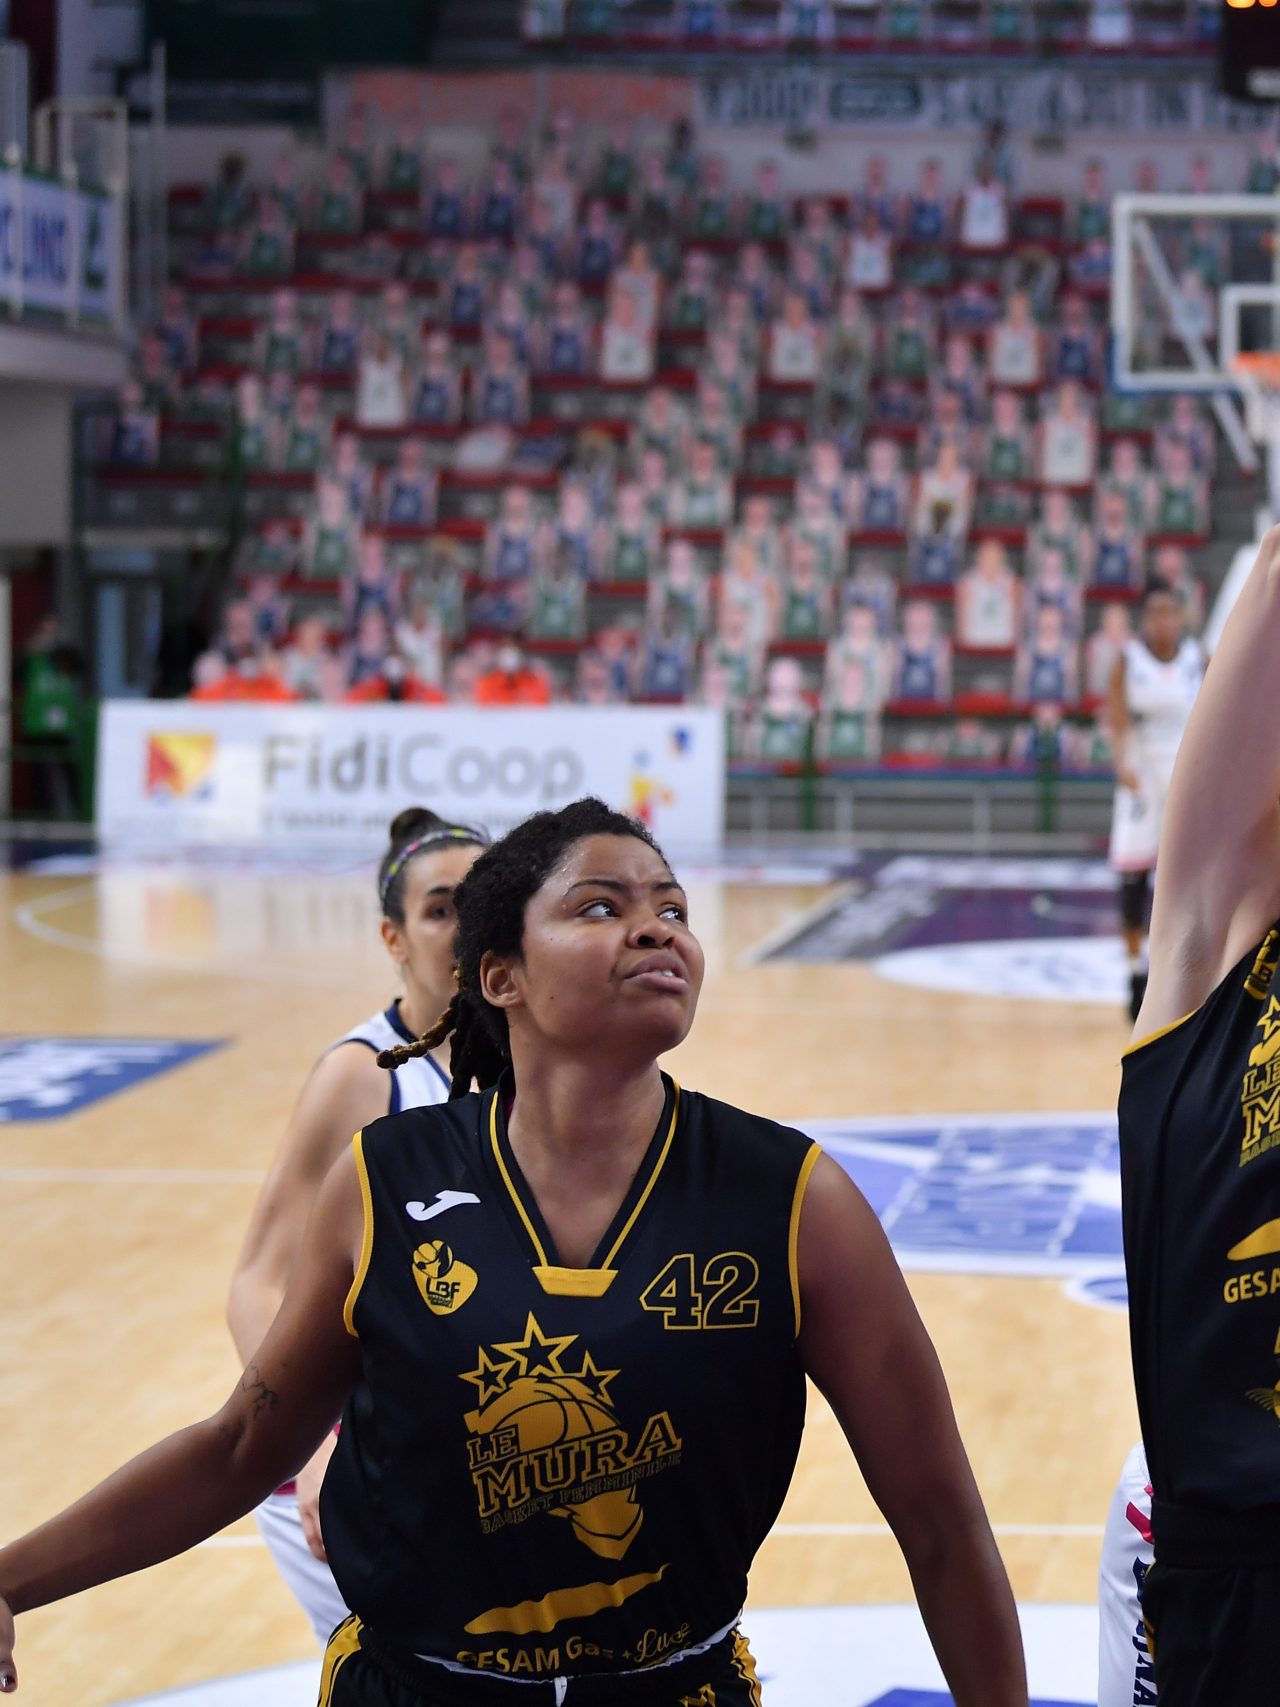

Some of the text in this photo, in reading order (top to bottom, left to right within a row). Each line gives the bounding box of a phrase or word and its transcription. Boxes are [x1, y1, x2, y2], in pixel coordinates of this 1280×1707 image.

[264, 732, 585, 802] FidiCoop
[640, 1251, 759, 1330] 42
[466, 1424, 520, 1469] LE
[472, 1411, 682, 1518] MURA
